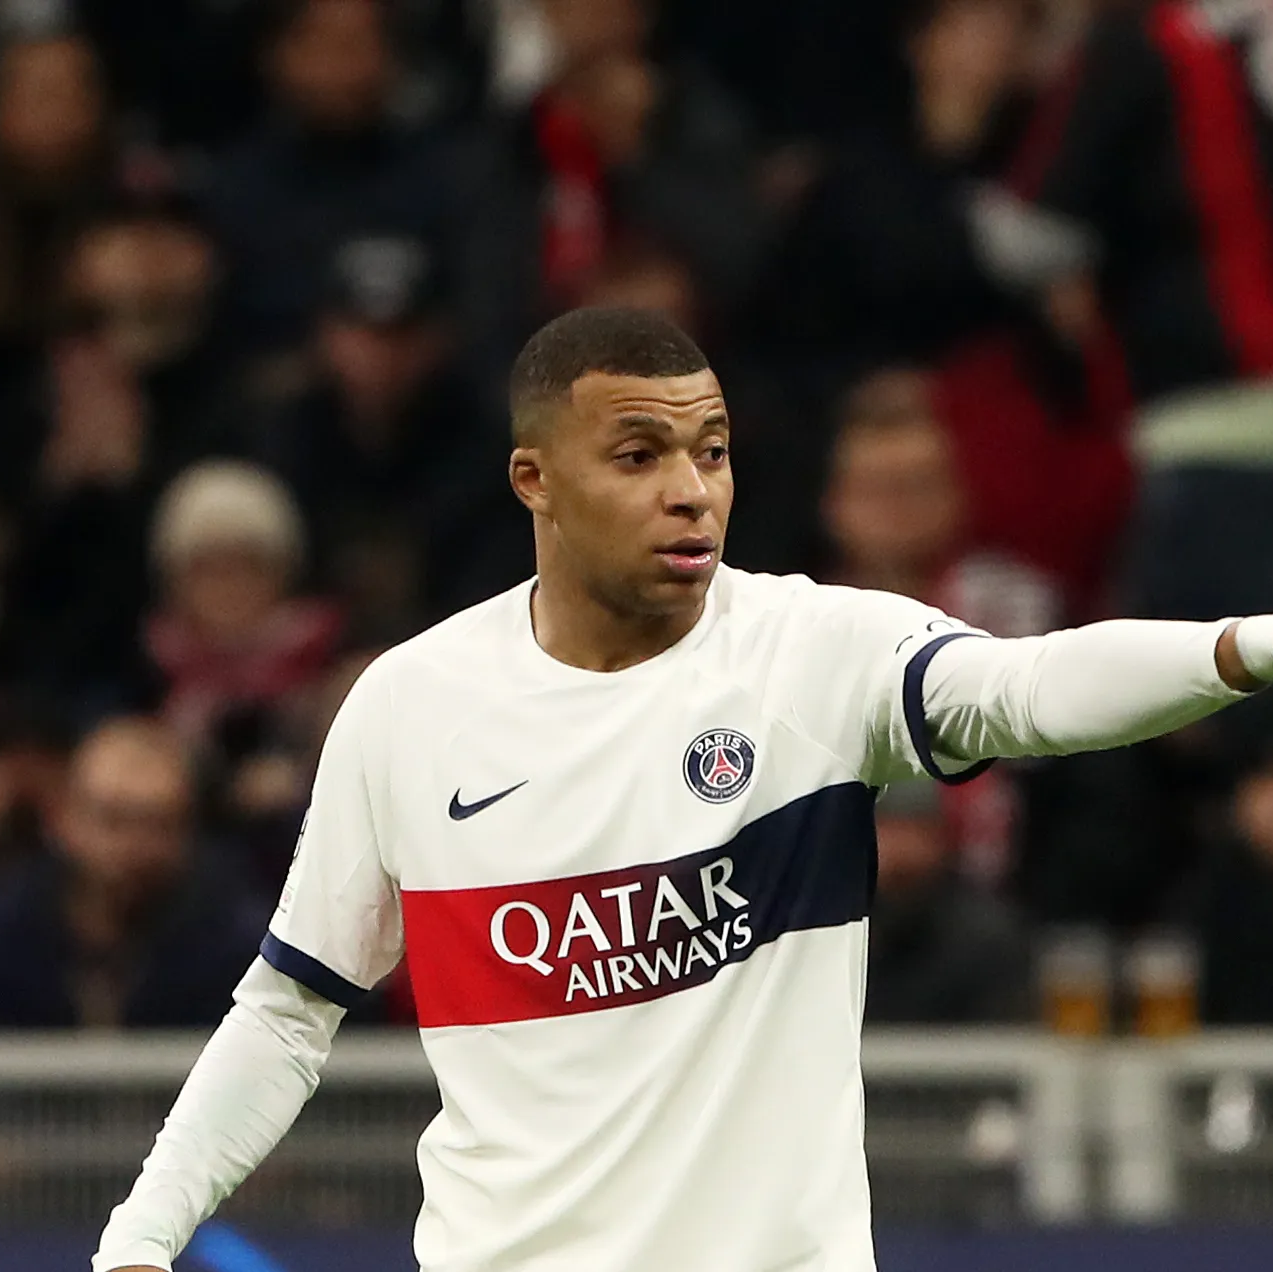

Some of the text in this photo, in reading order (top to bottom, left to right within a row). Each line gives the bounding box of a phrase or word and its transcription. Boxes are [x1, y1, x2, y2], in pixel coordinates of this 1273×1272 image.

[694, 733, 742, 755] PARIS
[490, 857, 749, 977] QATAR
[564, 913, 752, 1002] AIRWAYS
